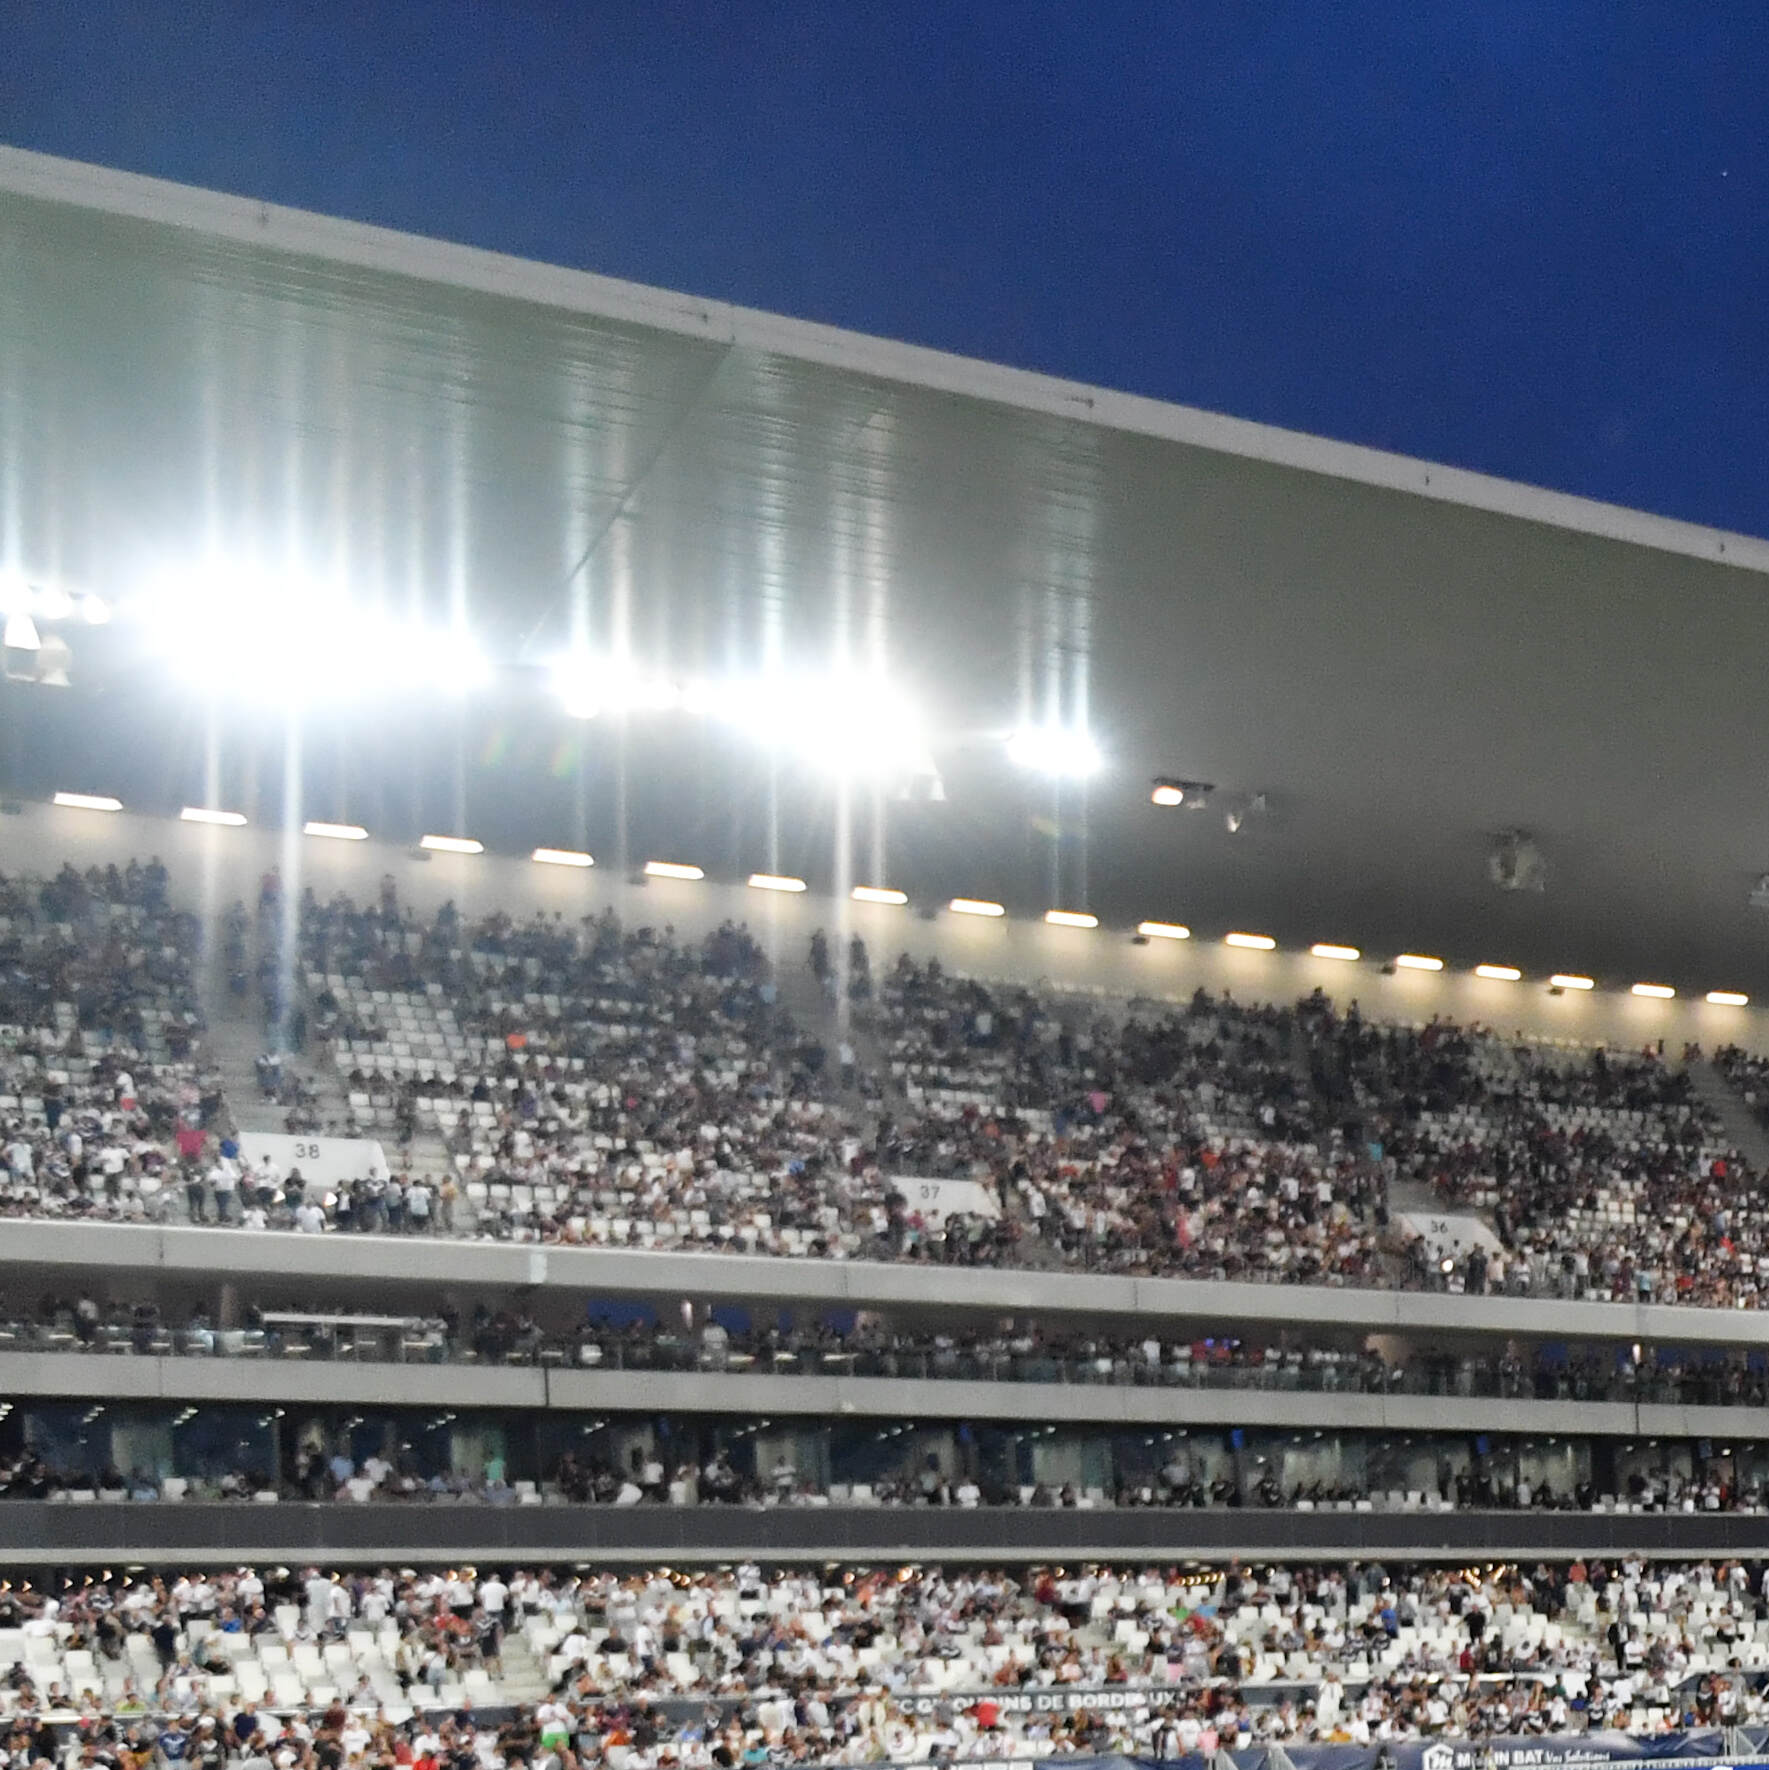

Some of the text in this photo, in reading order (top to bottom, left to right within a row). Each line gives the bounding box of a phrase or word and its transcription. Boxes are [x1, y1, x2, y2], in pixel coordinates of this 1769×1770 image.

[295, 1143, 320, 1159] 38
[920, 1185, 940, 1199] 37
[1431, 1220, 1448, 1234] 36
[1037, 1694, 1063, 1711] DE
[1513, 1750, 1544, 1764] BAT
